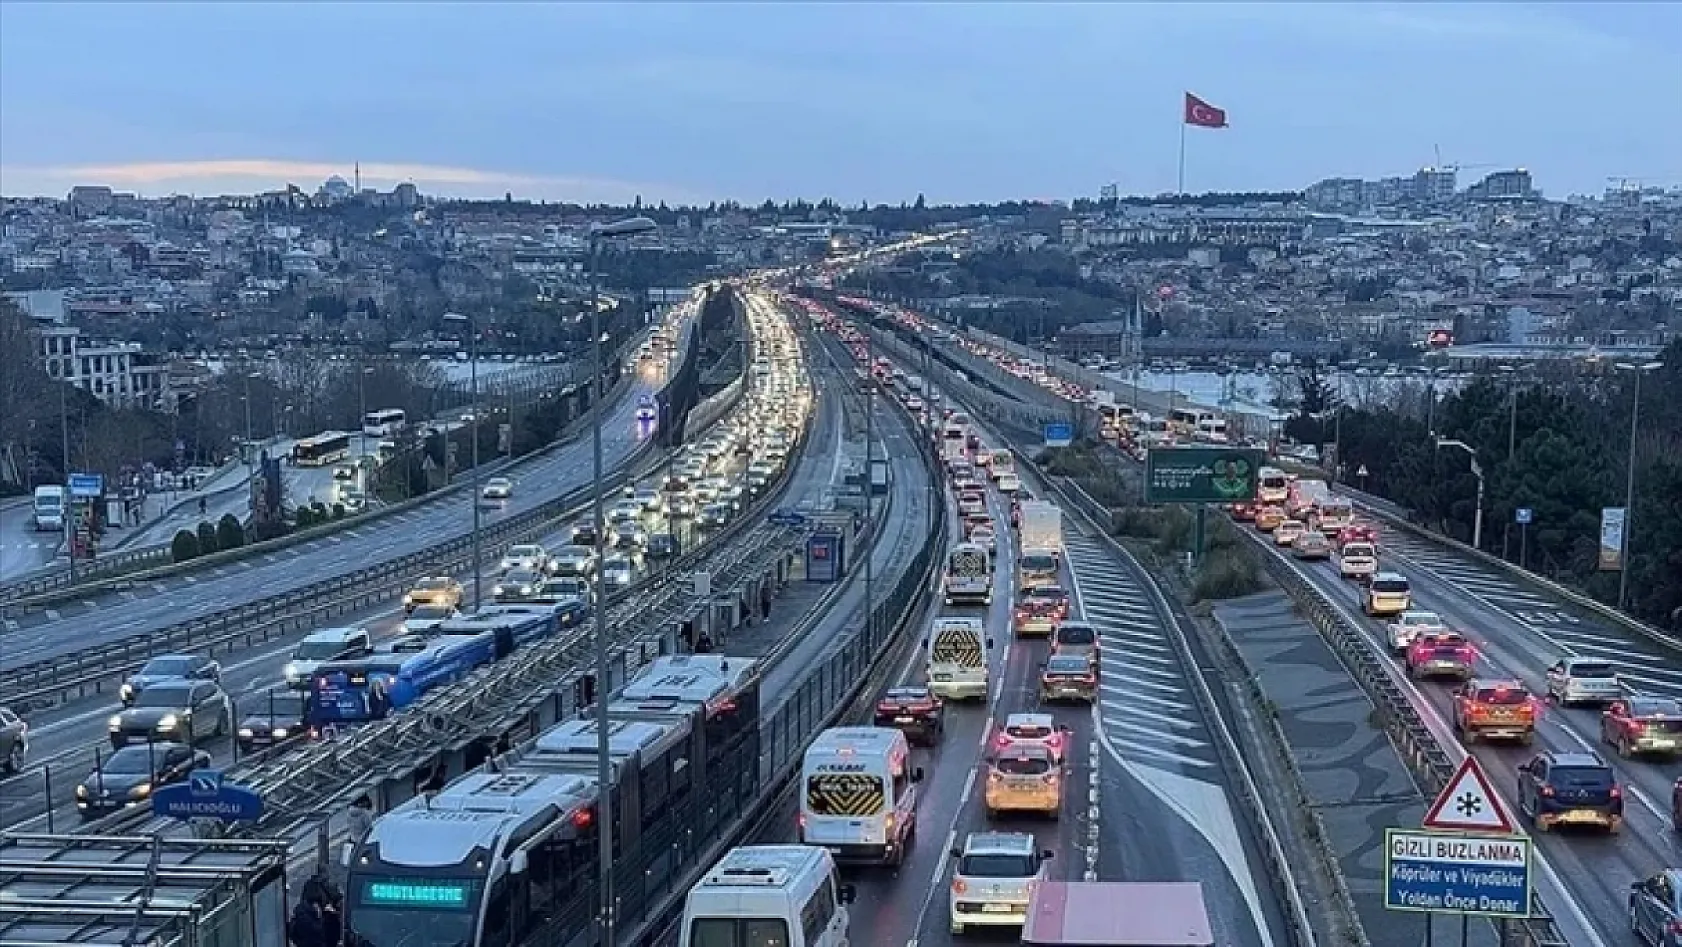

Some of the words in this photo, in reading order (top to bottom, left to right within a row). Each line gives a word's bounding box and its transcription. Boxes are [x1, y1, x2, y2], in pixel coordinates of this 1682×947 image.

[168, 801, 243, 813] HALICIOĞLU
[1437, 842, 1523, 862] BUZLANMA
[1392, 863, 1441, 883] Köprüler
[1443, 869, 1458, 882] ve
[1460, 867, 1524, 887] Viyadükler
[1397, 889, 1441, 906] Yoldan
[1444, 889, 1477, 909] Önce
[1479, 895, 1519, 912] Donar
